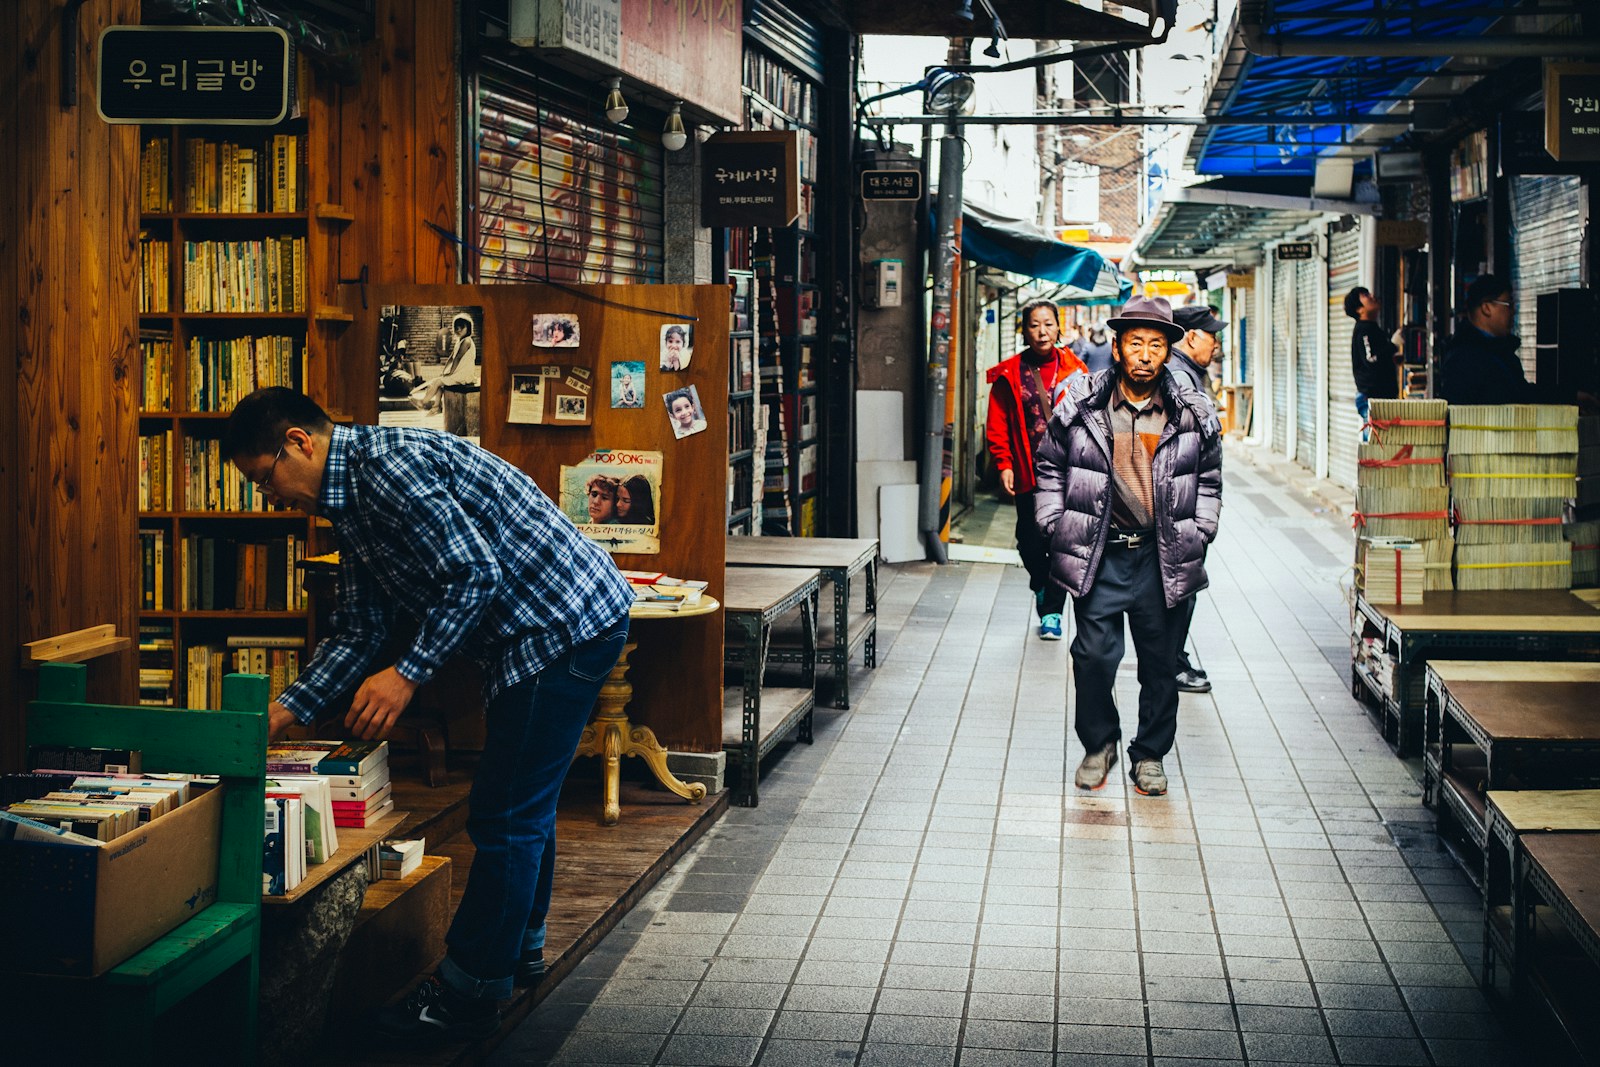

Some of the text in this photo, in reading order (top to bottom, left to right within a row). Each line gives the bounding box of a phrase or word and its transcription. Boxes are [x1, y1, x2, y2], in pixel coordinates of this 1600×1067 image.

[122, 59, 264, 91] 우리글방
[715, 167, 777, 184] 국제서적
[596, 454, 615, 463] POP
[618, 453, 643, 465] SONG
